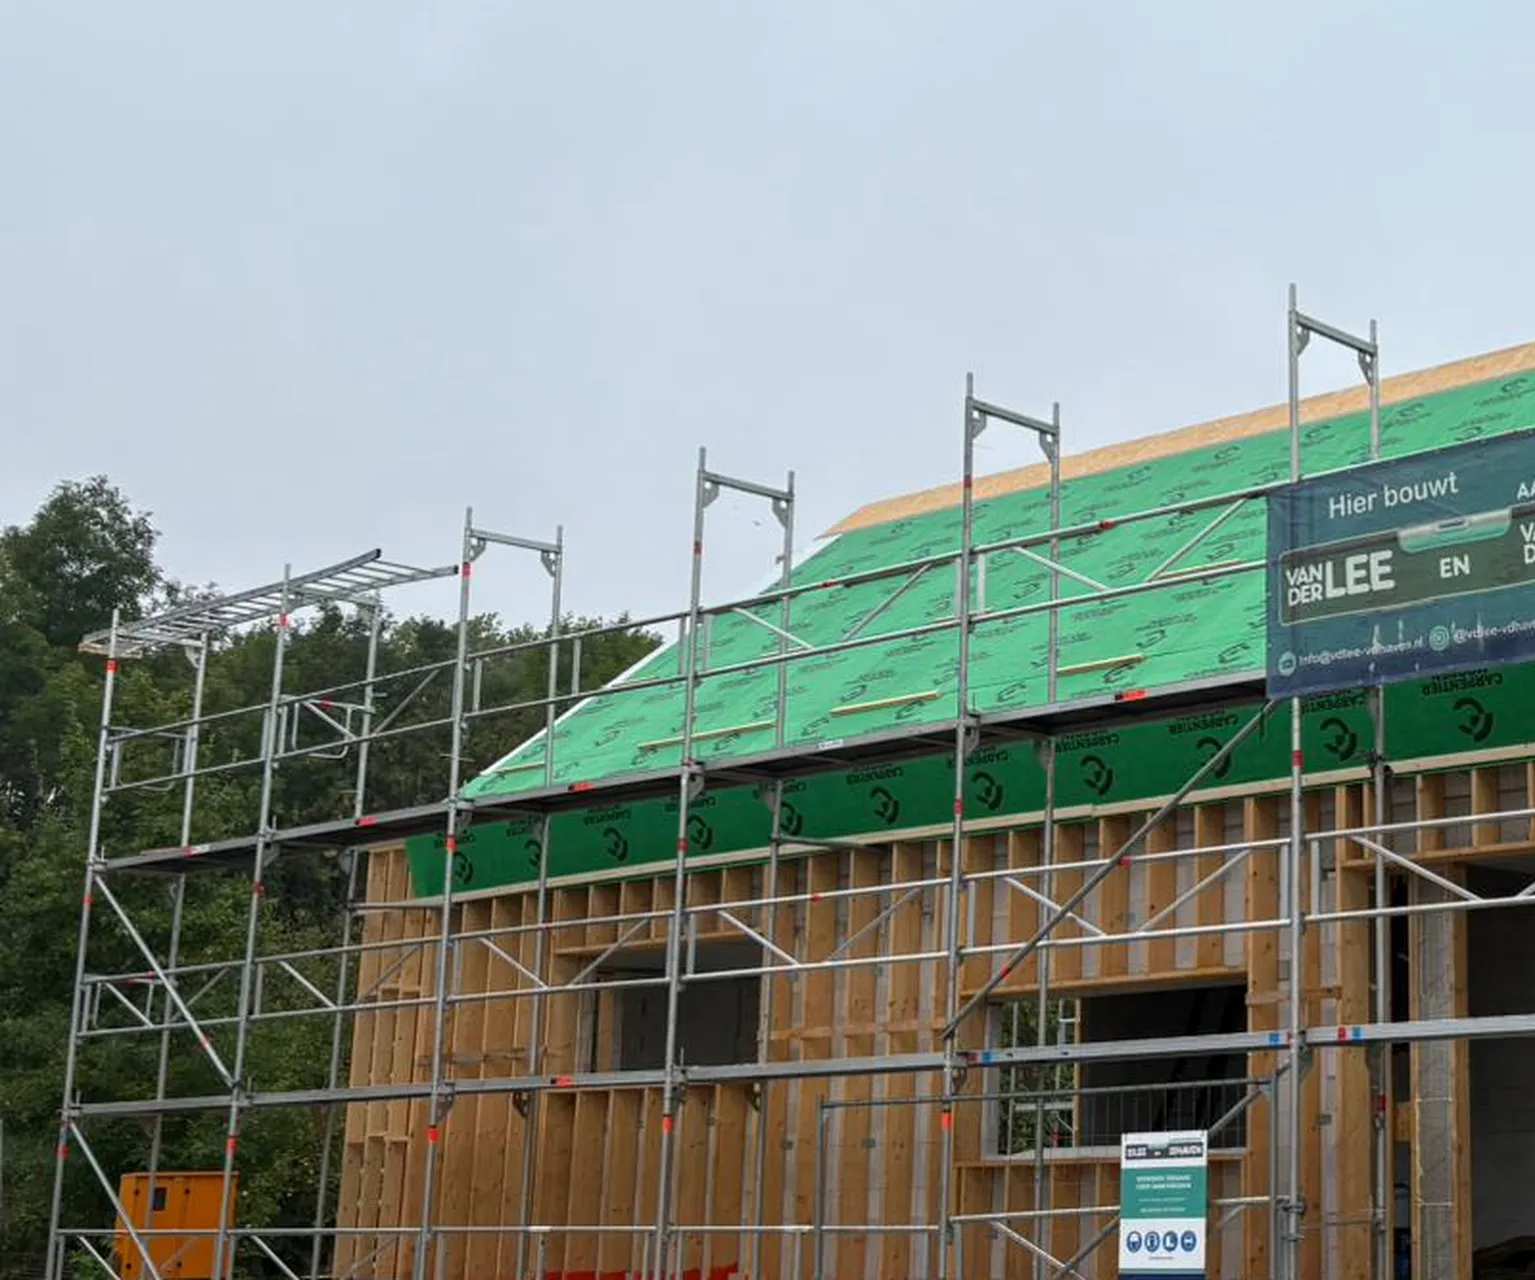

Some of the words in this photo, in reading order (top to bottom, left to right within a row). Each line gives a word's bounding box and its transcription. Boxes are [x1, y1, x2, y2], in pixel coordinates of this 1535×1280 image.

[1329, 492, 1377, 519] Hier
[1384, 472, 1459, 507] bouwt
[1285, 563, 1323, 586] VAN
[1325, 550, 1396, 599] LEE
[1439, 554, 1471, 579] EN
[1287, 584, 1324, 607] DER
